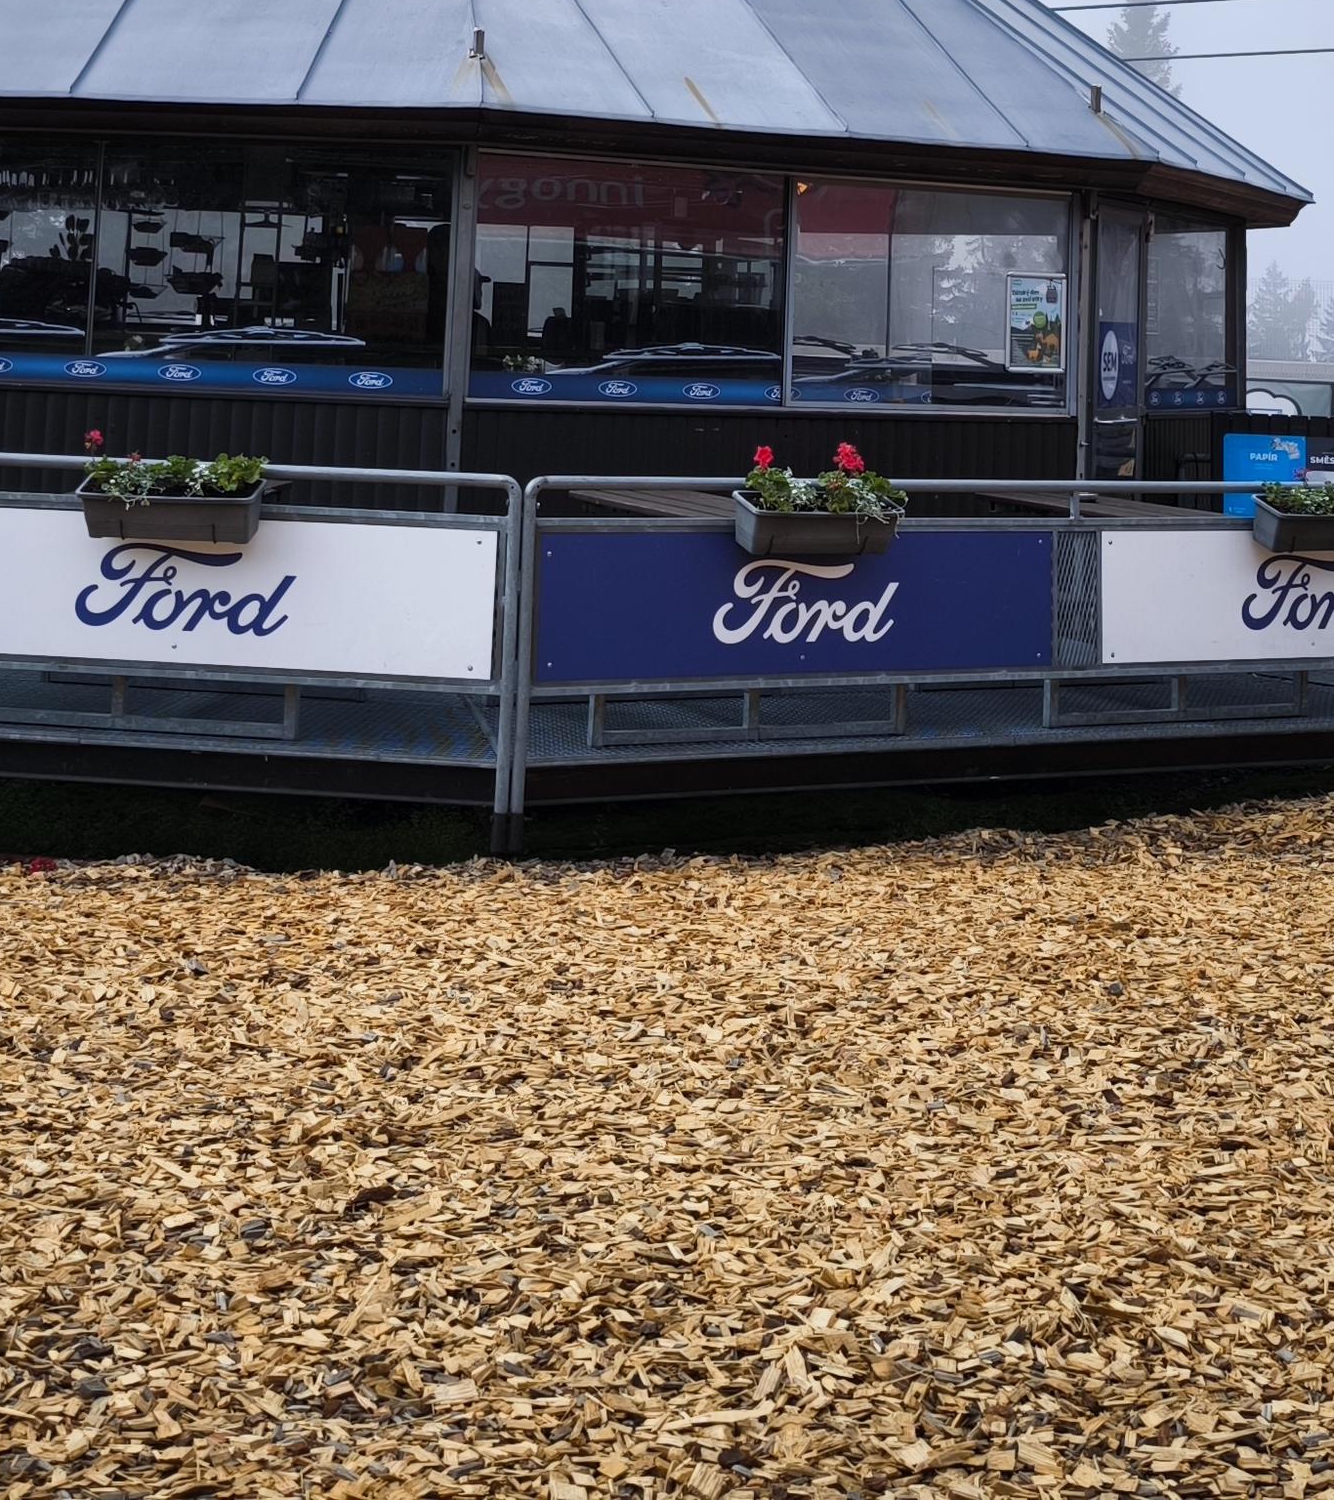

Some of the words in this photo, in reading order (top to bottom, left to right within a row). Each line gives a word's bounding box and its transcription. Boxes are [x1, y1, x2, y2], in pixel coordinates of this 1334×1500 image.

[1249, 452, 1278, 462] PAPÍR
[74, 542, 297, 637] Ford
[712, 559, 900, 645] Ford
